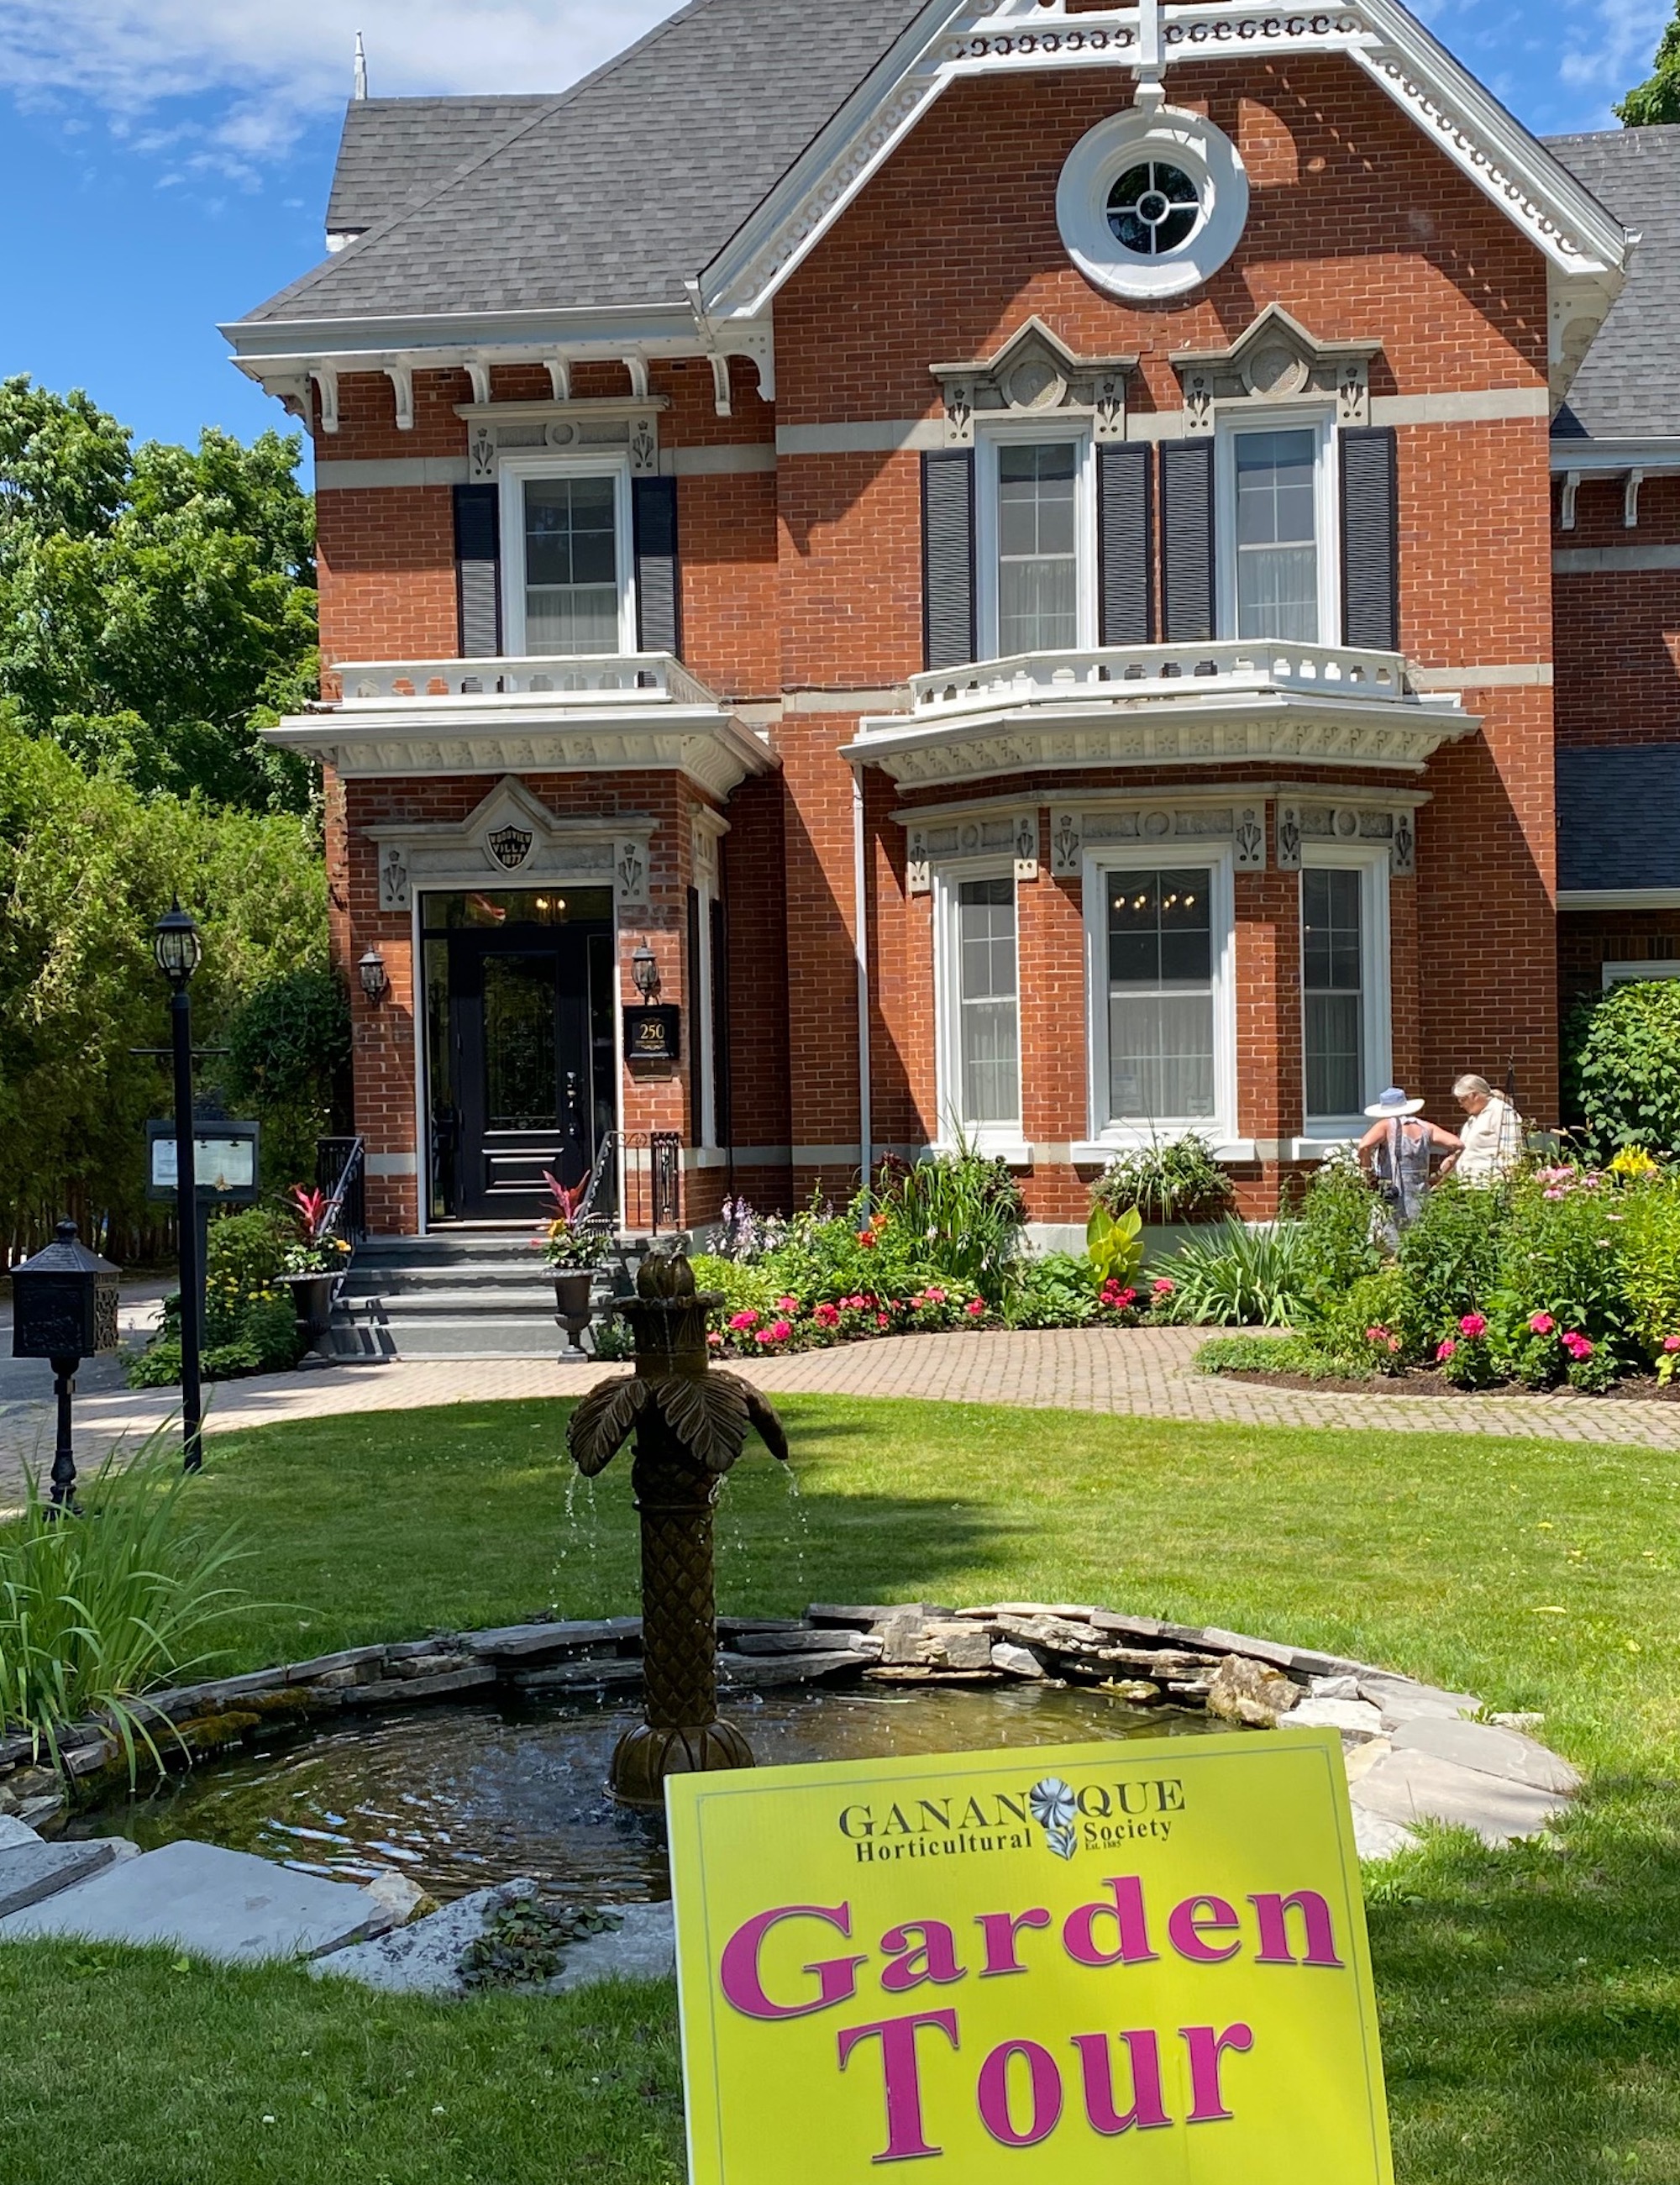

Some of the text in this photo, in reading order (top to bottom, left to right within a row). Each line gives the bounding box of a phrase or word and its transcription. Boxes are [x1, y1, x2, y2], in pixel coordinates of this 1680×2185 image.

[492, 843, 527, 853] VILLA
[640, 1023, 664, 1039] 250
[839, 1778, 1185, 1839] GANANQUE
[855, 1818, 1172, 1863] Horticultural Society
[720, 1875, 1346, 2020] Garden
[837, 2008, 1254, 2164] Tour
